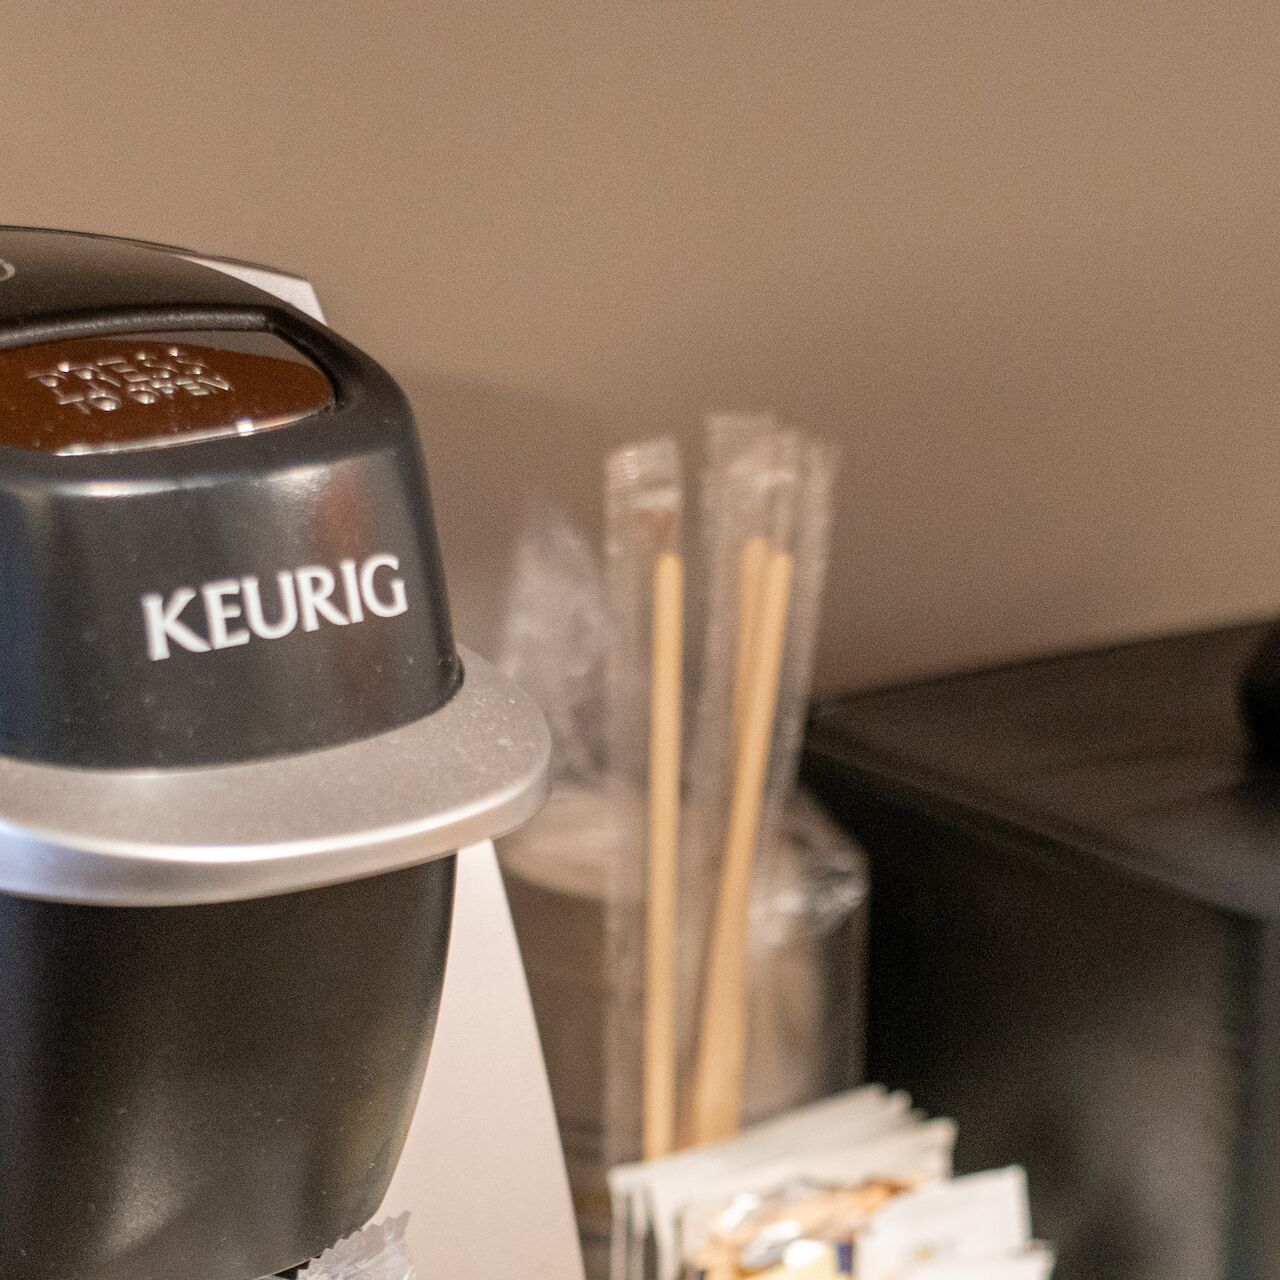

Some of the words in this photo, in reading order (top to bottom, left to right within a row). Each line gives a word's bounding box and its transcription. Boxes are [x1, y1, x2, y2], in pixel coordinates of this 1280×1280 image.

[58, 388, 121, 415] TO
[129, 374, 234, 404] OPEN
[141, 553, 409, 662] KEURIG
